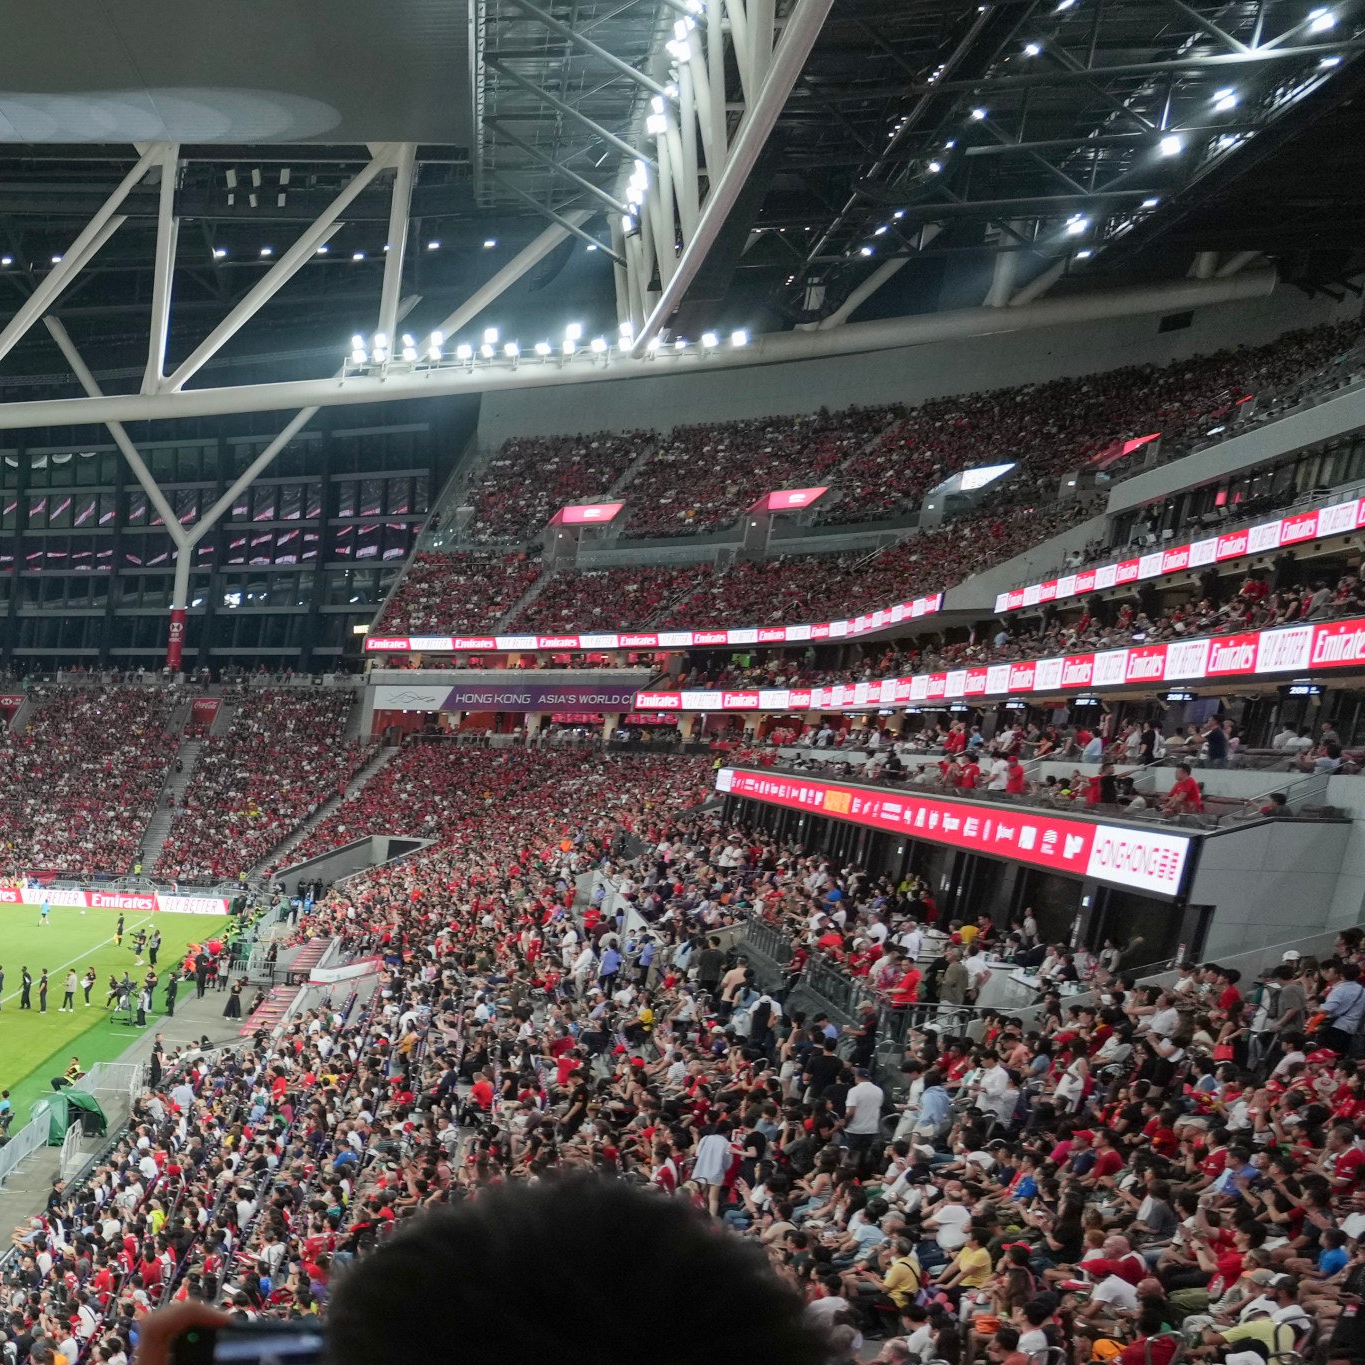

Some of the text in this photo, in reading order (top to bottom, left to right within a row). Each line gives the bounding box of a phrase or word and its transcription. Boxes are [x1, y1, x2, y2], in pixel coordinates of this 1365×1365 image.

[1283, 518, 1316, 537] Emirates
[1220, 537, 1246, 556] Emirates
[368, 639, 408, 649] Emirates
[455, 638, 494, 648] Emirates
[540, 637, 577, 647] Emirates
[620, 636, 656, 646] Emirates
[694, 633, 726, 643] Emirates
[1212, 639, 1255, 671] Emirates
[1130, 651, 1164, 678] Emirates
[456, 694, 619, 704] HONG KONG ASIA'S WORLD
[637, 694, 678, 707] Emirates
[724, 694, 758, 706] Emirates
[29, 890, 77, 905] FLY BETTER
[92, 894, 152, 909] Emirates
[165, 898, 217, 912] FLY BETTER
